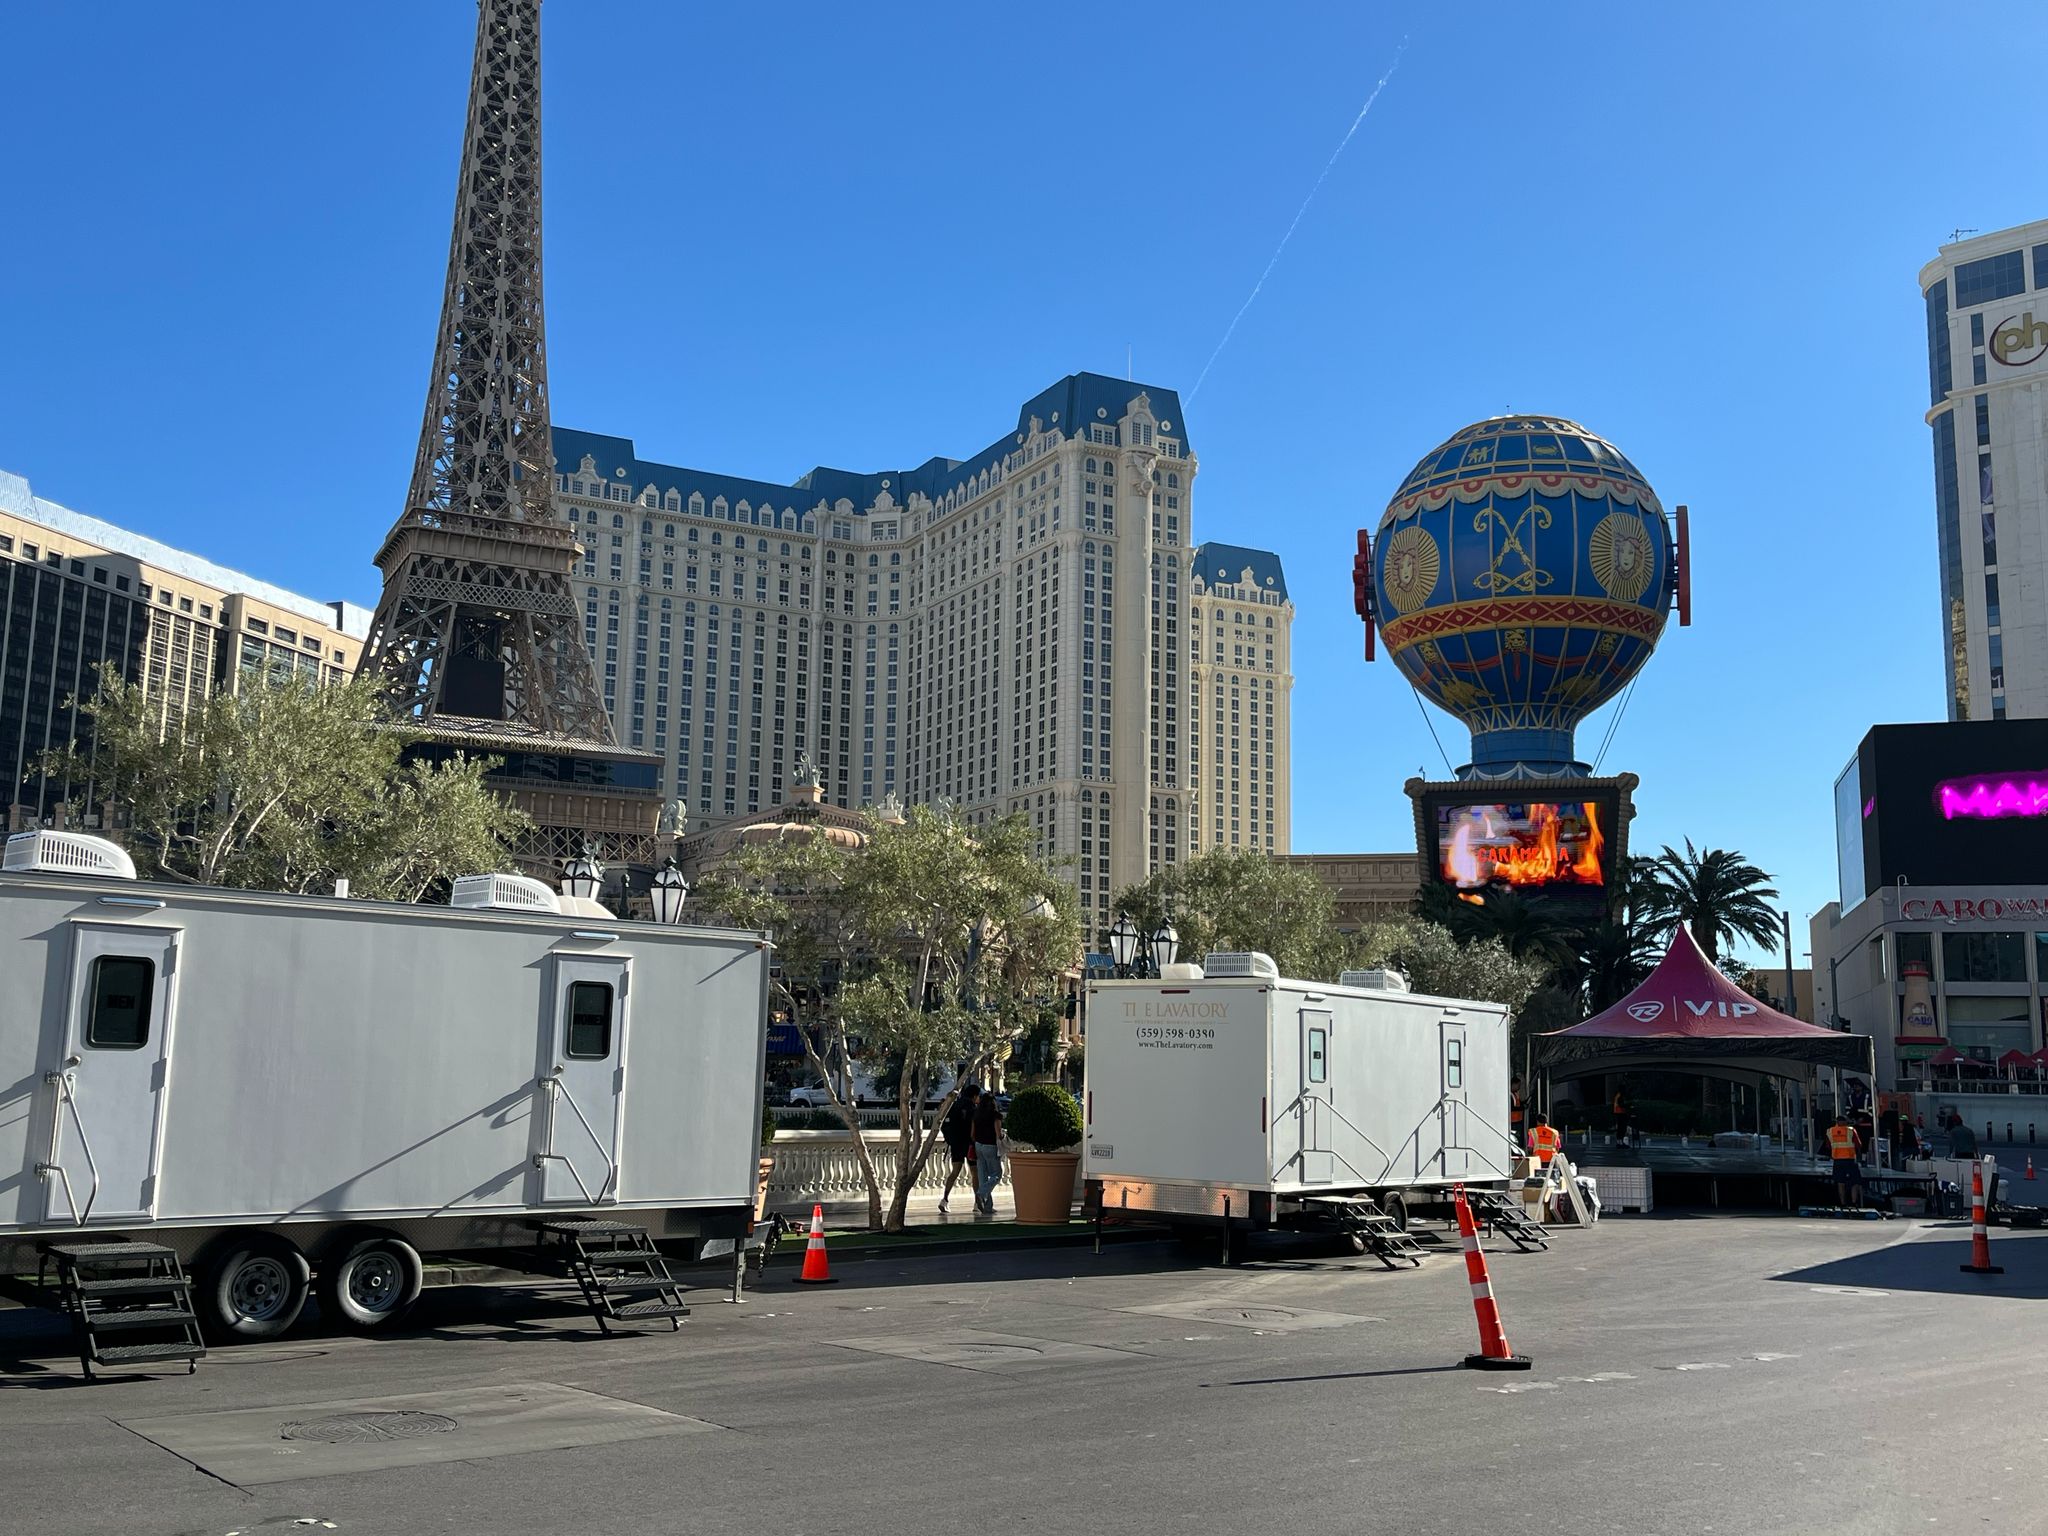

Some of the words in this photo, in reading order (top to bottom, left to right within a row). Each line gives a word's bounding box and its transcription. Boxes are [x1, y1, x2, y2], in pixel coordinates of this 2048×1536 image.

[469, 737, 505, 749] TOWER
[510, 741, 572, 755] RESTAURANT
[1477, 847, 1569, 863] CARAMEA
[1156, 1002, 1230, 1018] LAVATORY
[1684, 1000, 1757, 1018] VIP
[1138, 1041, 1213, 1051] www.TheLavatory.com
